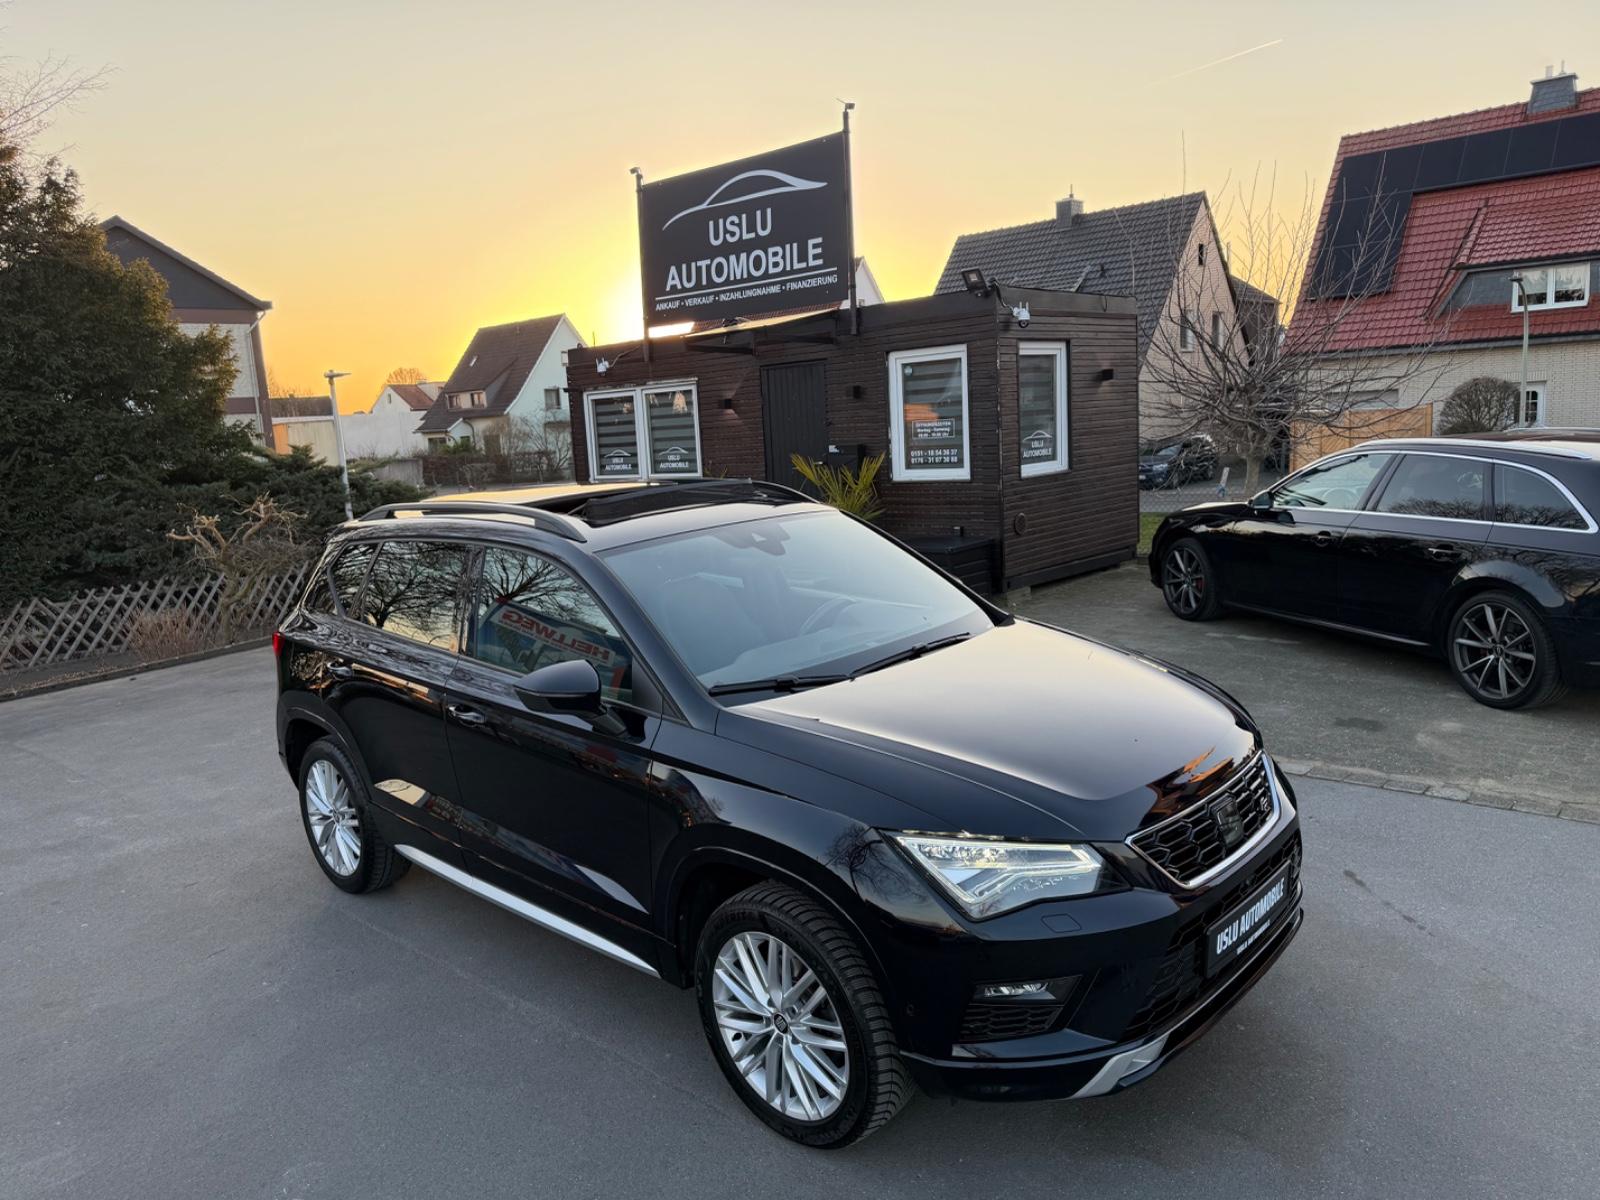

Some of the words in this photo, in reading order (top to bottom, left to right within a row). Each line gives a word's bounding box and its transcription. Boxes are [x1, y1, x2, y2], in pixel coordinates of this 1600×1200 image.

[708, 207, 773, 247] USLU
[665, 237, 824, 292] AUTOMOBILE
[655, 300, 681, 311] ANKAUF
[684, 295, 715, 307] VERKAUF
[719, 284, 782, 302] INZAHLUNGNAHME
[786, 274, 838, 291] FINANZIERUNG
[1216, 919, 1239, 955] USLU
[1239, 877, 1285, 937] AUTOMOBILE
